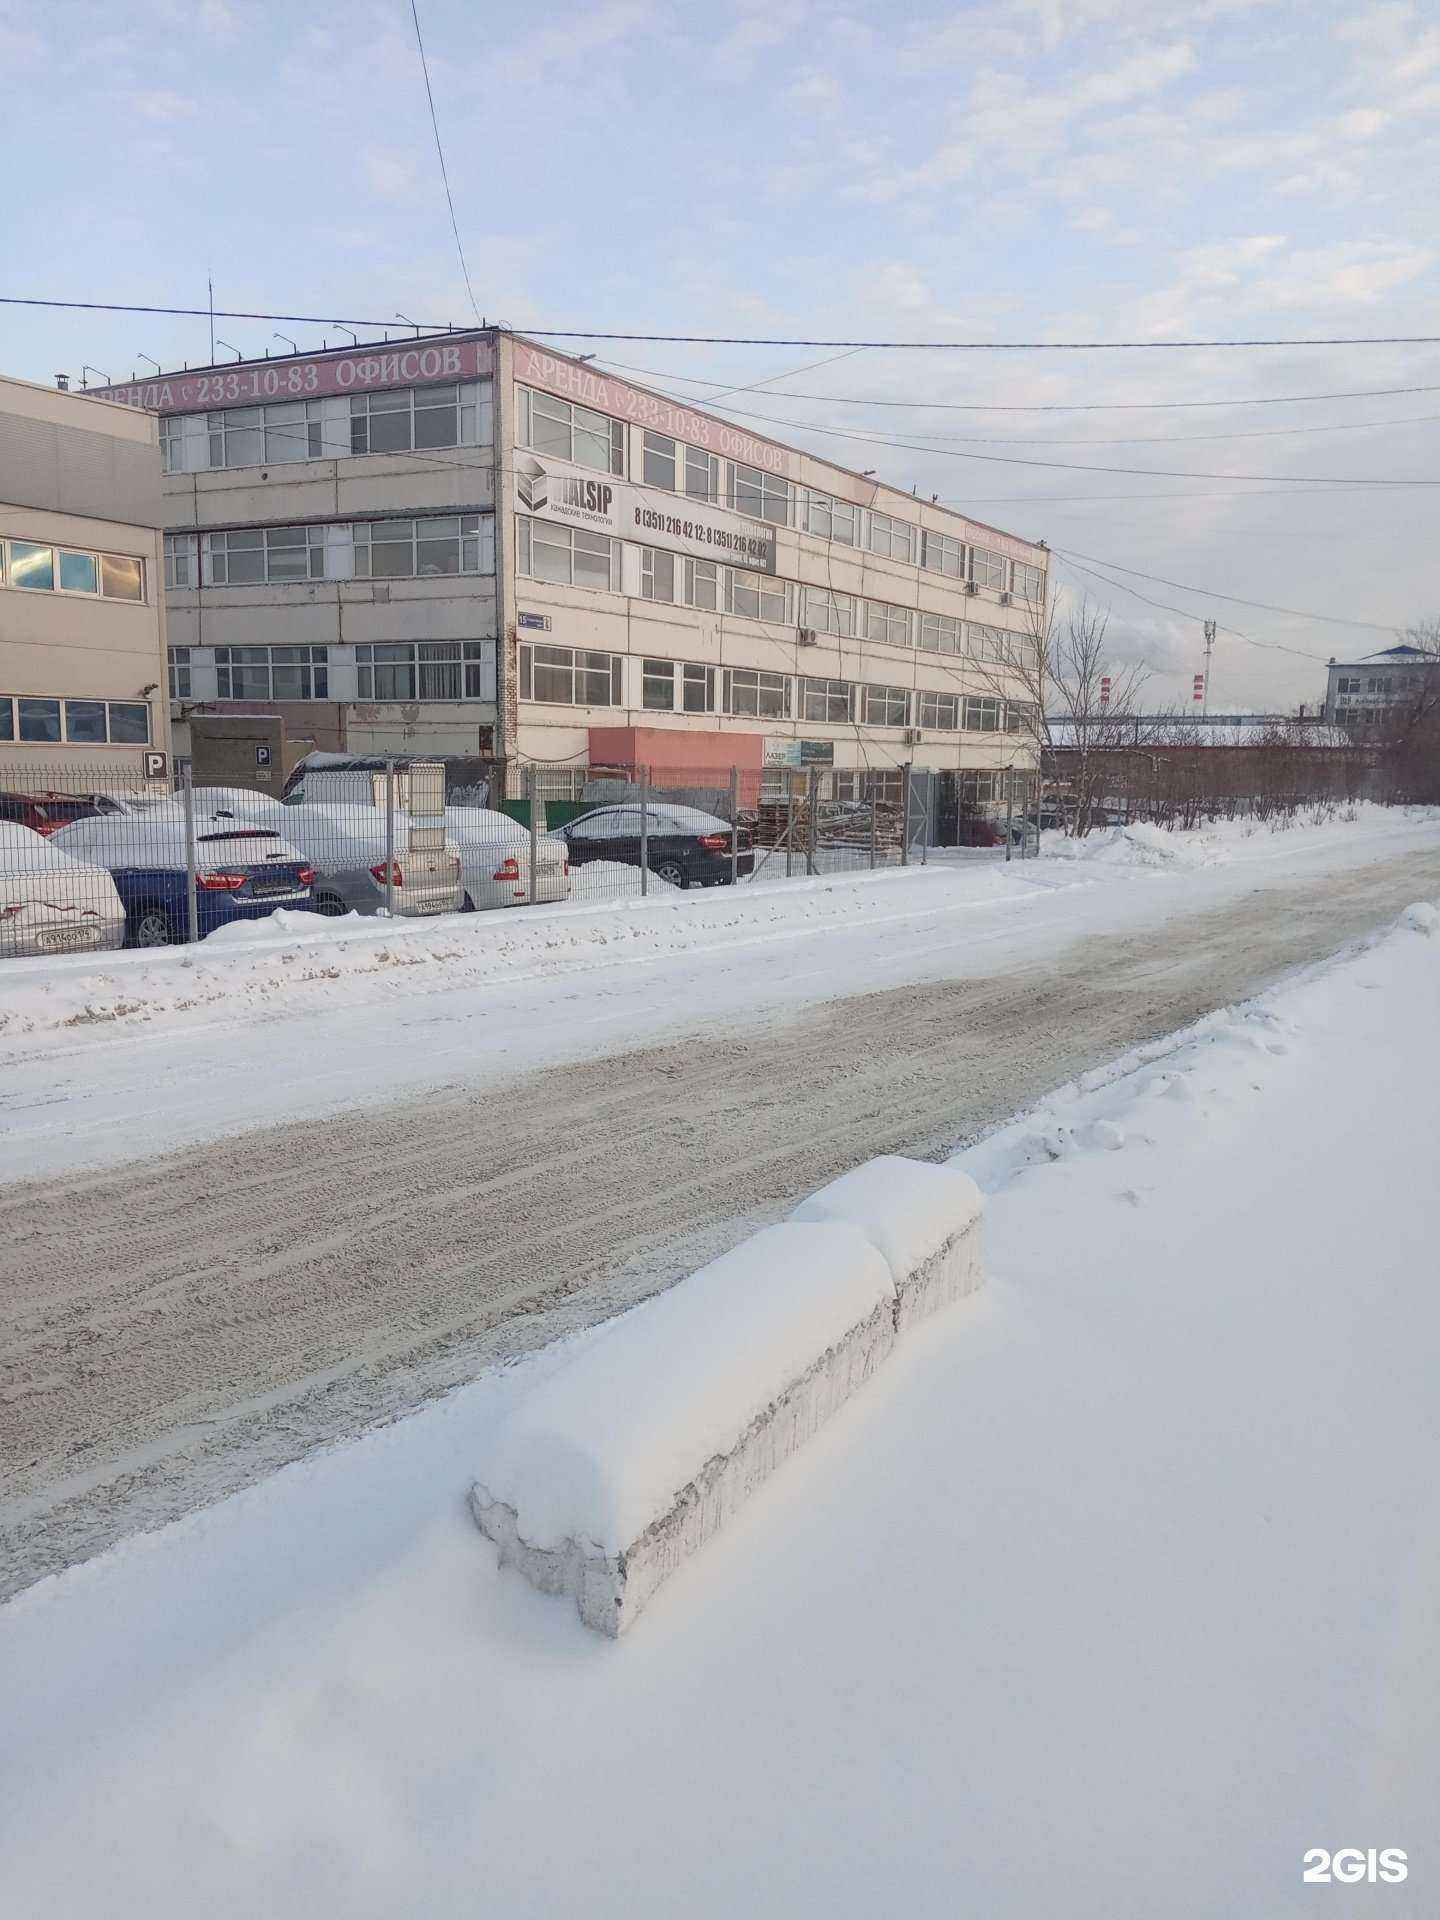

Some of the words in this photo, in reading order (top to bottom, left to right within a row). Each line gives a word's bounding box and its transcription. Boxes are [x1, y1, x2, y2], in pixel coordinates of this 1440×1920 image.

[91, 382, 175, 408] РЕНДА
[198, 364, 319, 403] 233-10-83
[336, 347, 462, 386] ОФИСОВ
[527, 352, 609, 408] АРЕНДА
[626, 391, 709, 445] 233-10-83
[719, 428, 782, 471] ОФИСОВ
[634, 507, 641, 525] 8
[643, 509, 665, 531] (351)
[666, 516, 681, 536] 216
[682, 520, 693, 539] 42
[706, 527, 712, 543] 8
[713, 528, 733, 549] (351)
[733, 534, 747, 553] 216
